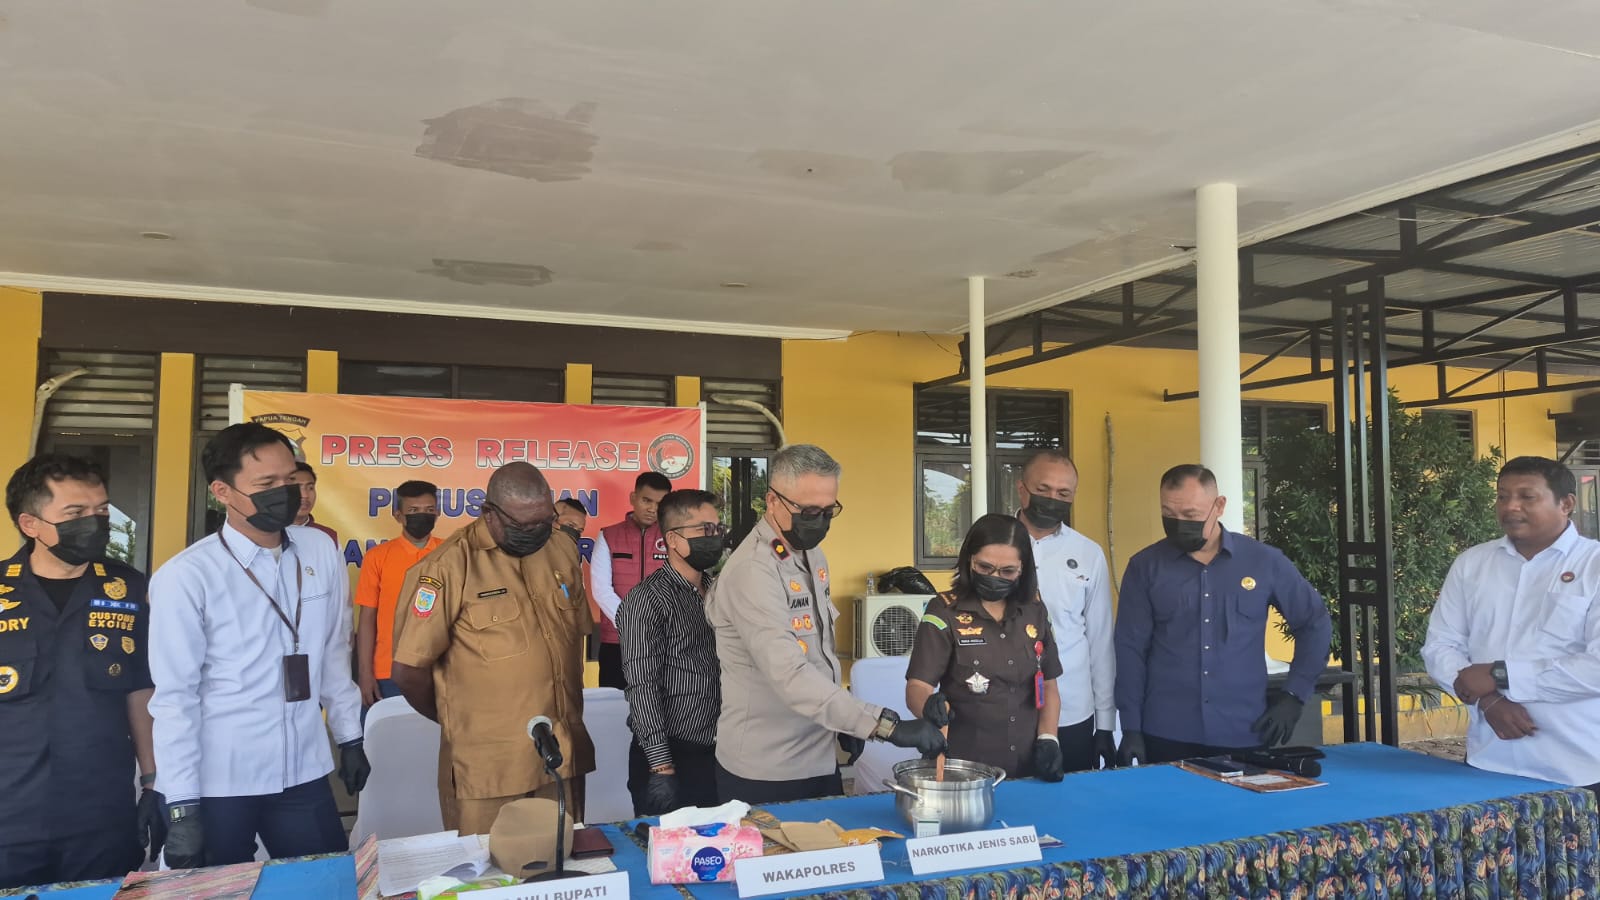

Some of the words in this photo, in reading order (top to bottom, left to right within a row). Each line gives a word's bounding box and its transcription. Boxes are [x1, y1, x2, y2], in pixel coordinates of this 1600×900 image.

[320, 435, 453, 468] PRESS
[475, 438, 641, 471] RELEASE
[88, 619, 134, 631] EXCISE
[89, 612, 136, 624] CUSTOMS
[912, 842, 974, 858] NARKOTIKA
[977, 838, 1007, 850] JENIS
[1009, 834, 1037, 846] SABU
[694, 856, 722, 866] PASEO
[762, 861, 856, 883] WAKAPOLRES
[554, 886, 607, 900] BUPATI
